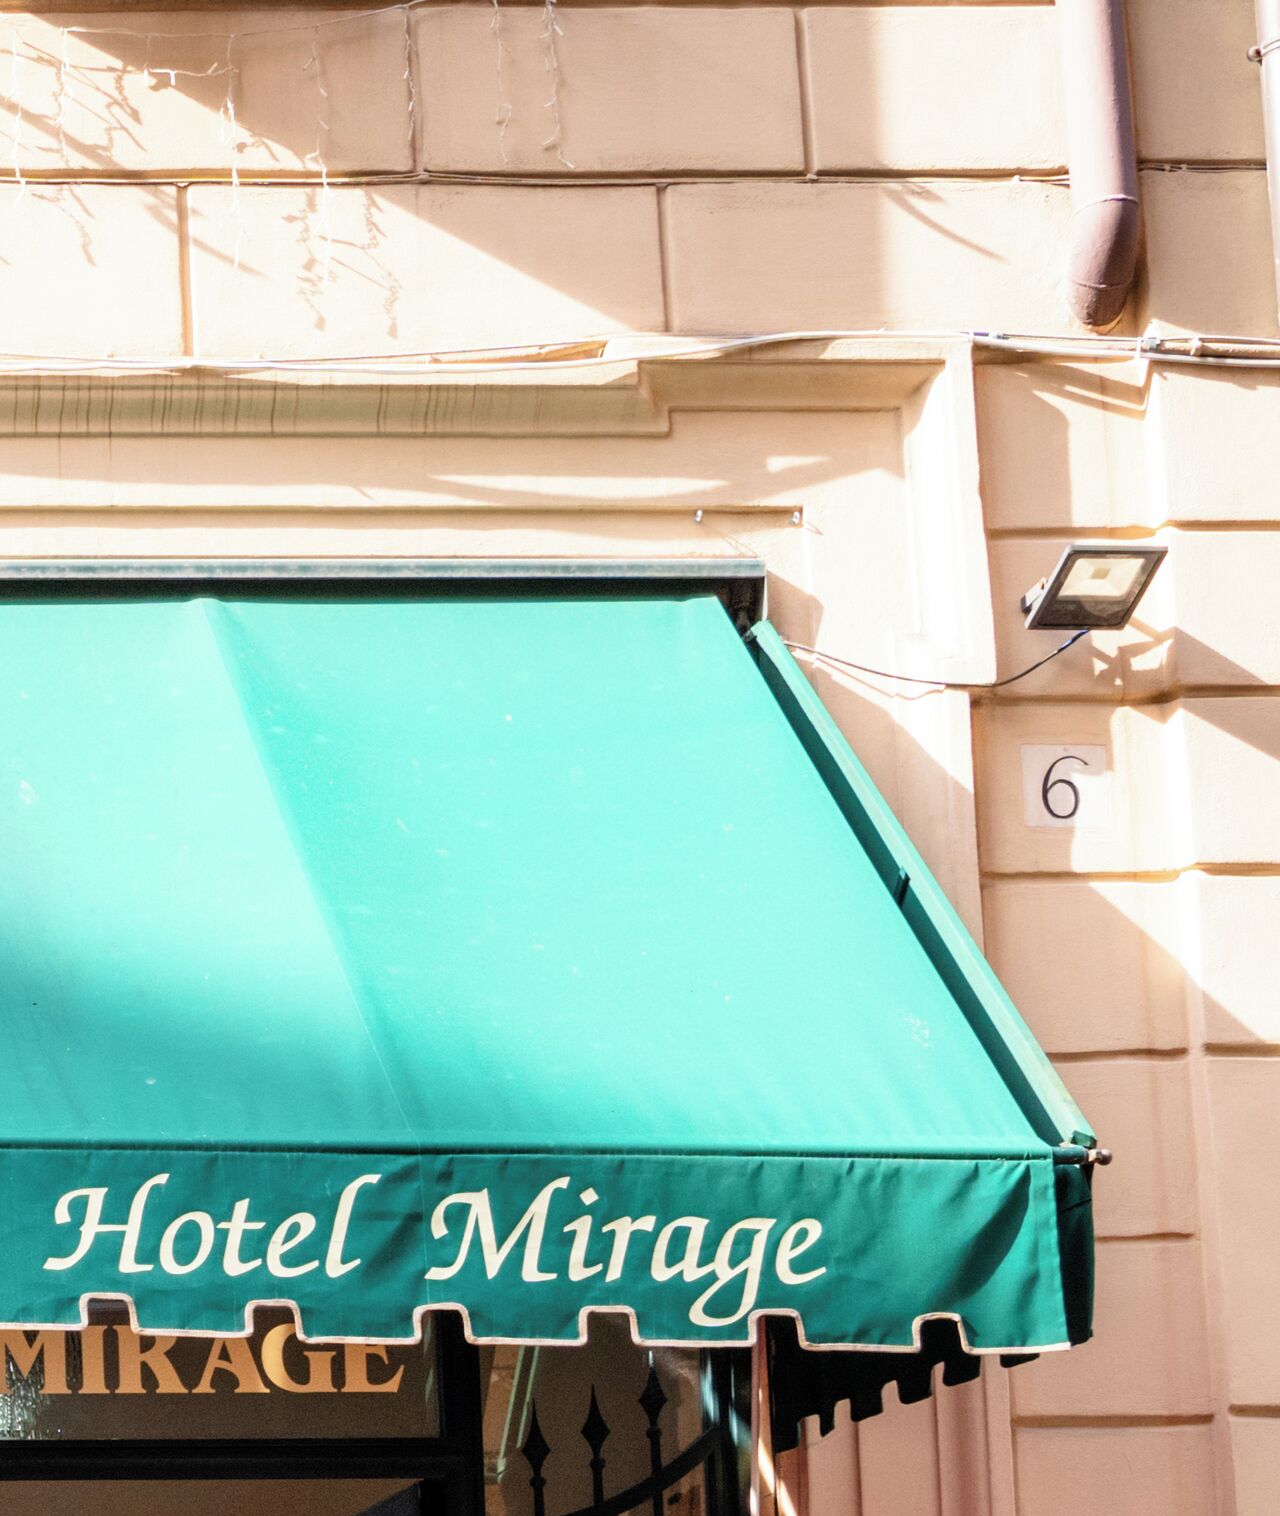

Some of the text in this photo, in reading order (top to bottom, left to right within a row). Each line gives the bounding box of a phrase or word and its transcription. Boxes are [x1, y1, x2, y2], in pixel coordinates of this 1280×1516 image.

[1041, 755, 1089, 819] 6
[43, 1172, 827, 1327] Hotel Mirage
